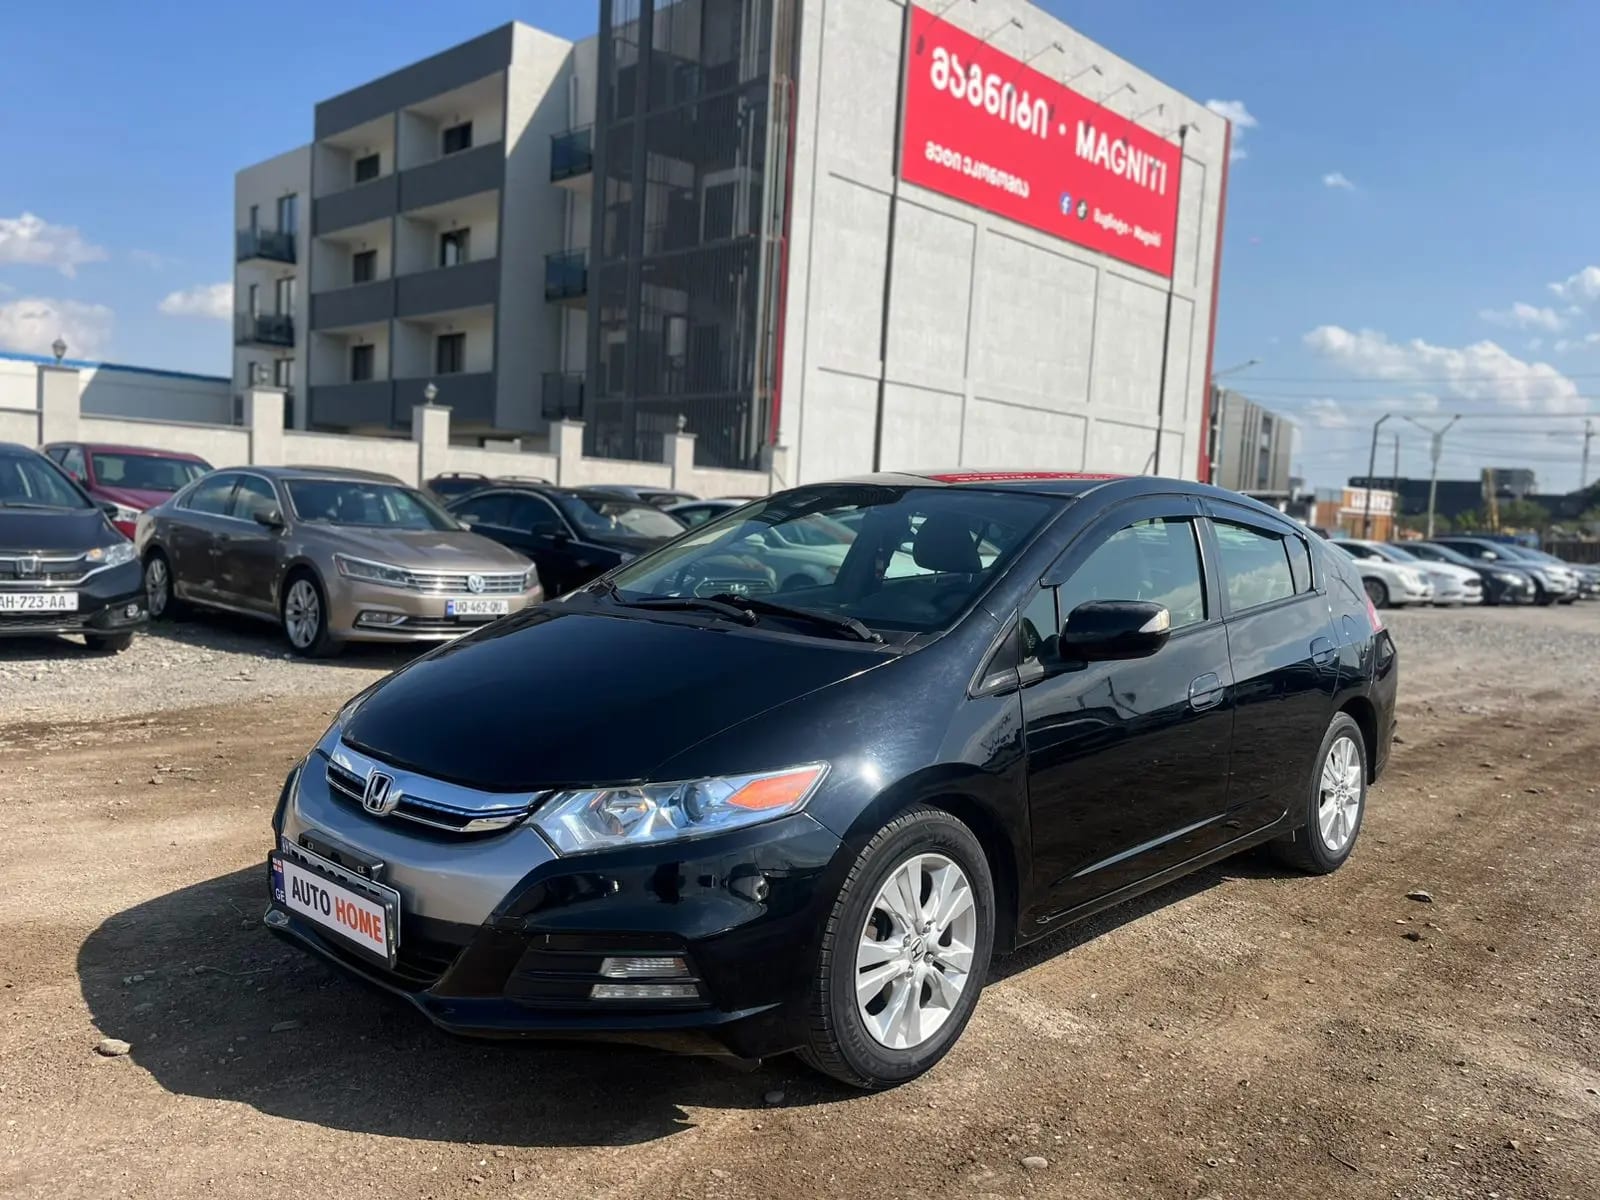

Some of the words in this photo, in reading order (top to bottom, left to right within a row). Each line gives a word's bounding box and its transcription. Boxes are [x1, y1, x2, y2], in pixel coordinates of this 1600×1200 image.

[930, 47, 1049, 139] მაგნიტი
[1075, 120, 1167, 195] MAGNITI
[275, 888, 285, 903] GE
[292, 876, 331, 916] AUTO
[334, 896, 383, 943] HOME
